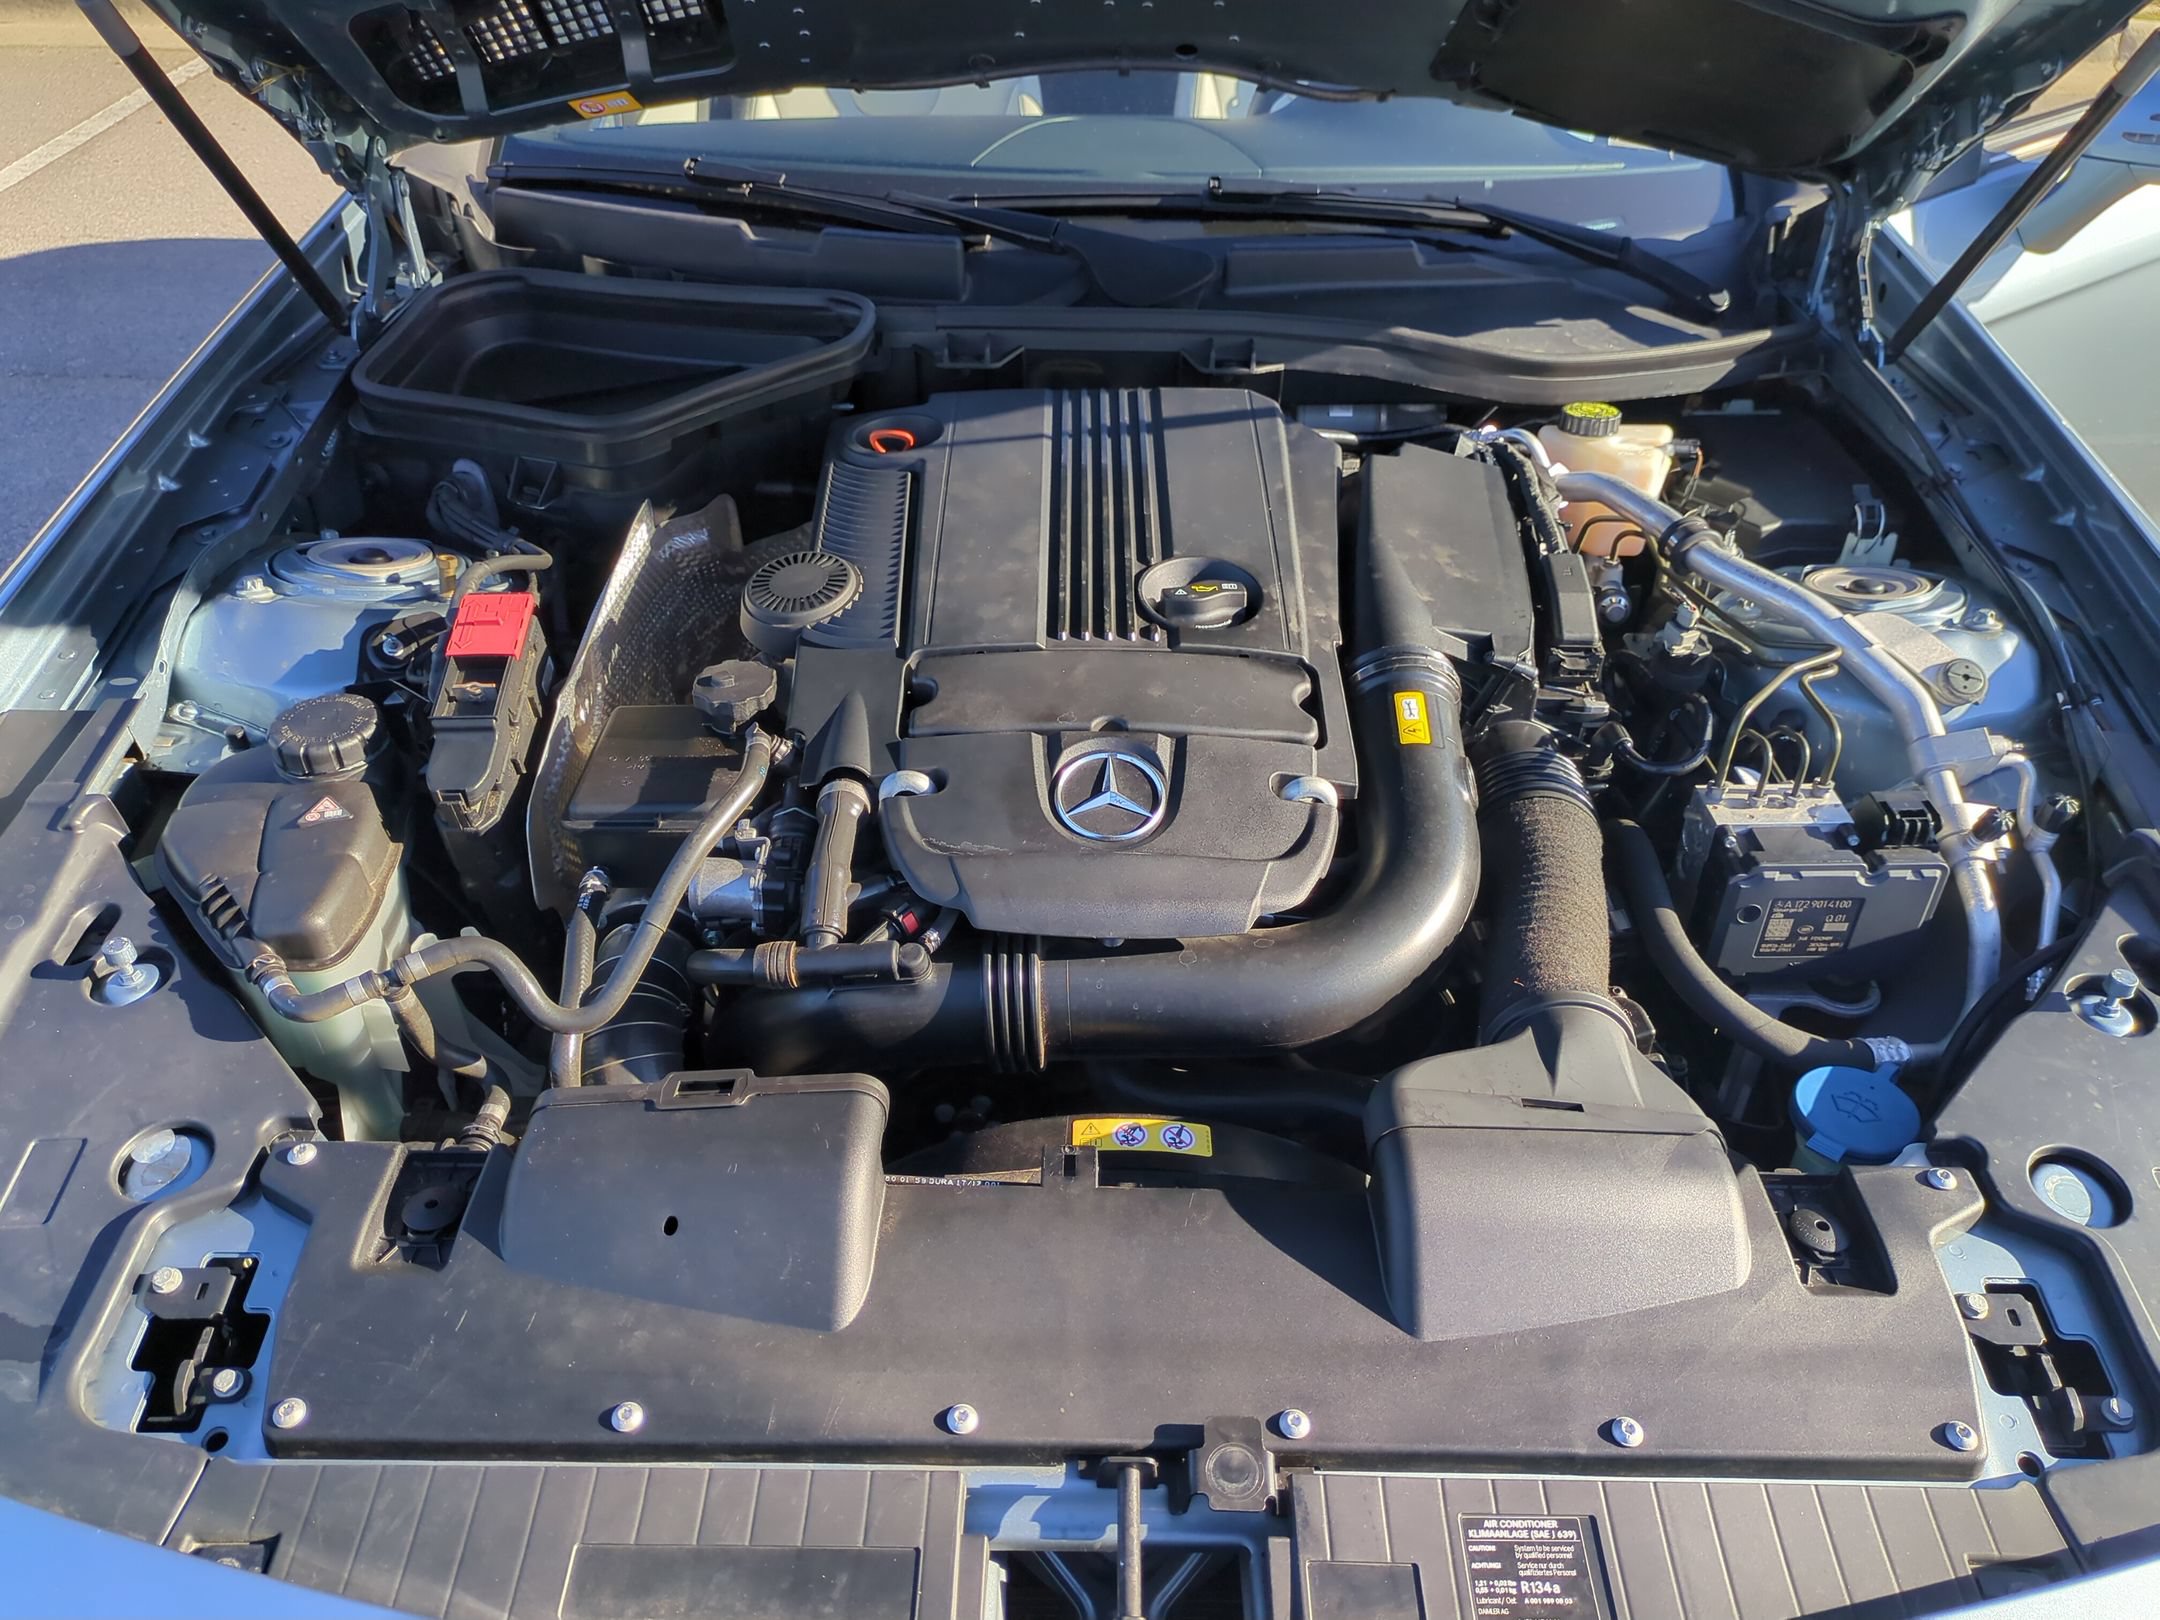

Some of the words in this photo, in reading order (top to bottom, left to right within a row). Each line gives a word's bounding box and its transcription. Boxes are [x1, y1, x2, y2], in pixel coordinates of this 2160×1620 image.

[1783, 900, 1792, 909] A
[1795, 900, 1810, 909] 172
[1483, 1520, 1499, 1528] AIR
[1500, 1520, 1559, 1529] CONDITIONER
[1468, 1529, 1530, 1539] KLIMAANLAGE
[1531, 1529, 1551, 1540] (SAE
[1557, 1530, 1577, 1541] 639)
[1514, 1544, 1536, 1553] System
[1543, 1544, 1551, 1552] be
[1515, 1551, 1523, 1560] by
[1517, 1561, 1539, 1569] Service
[1520, 1580, 1561, 1594] R134a
[1476, 1597, 1502, 1605] Lubricant
